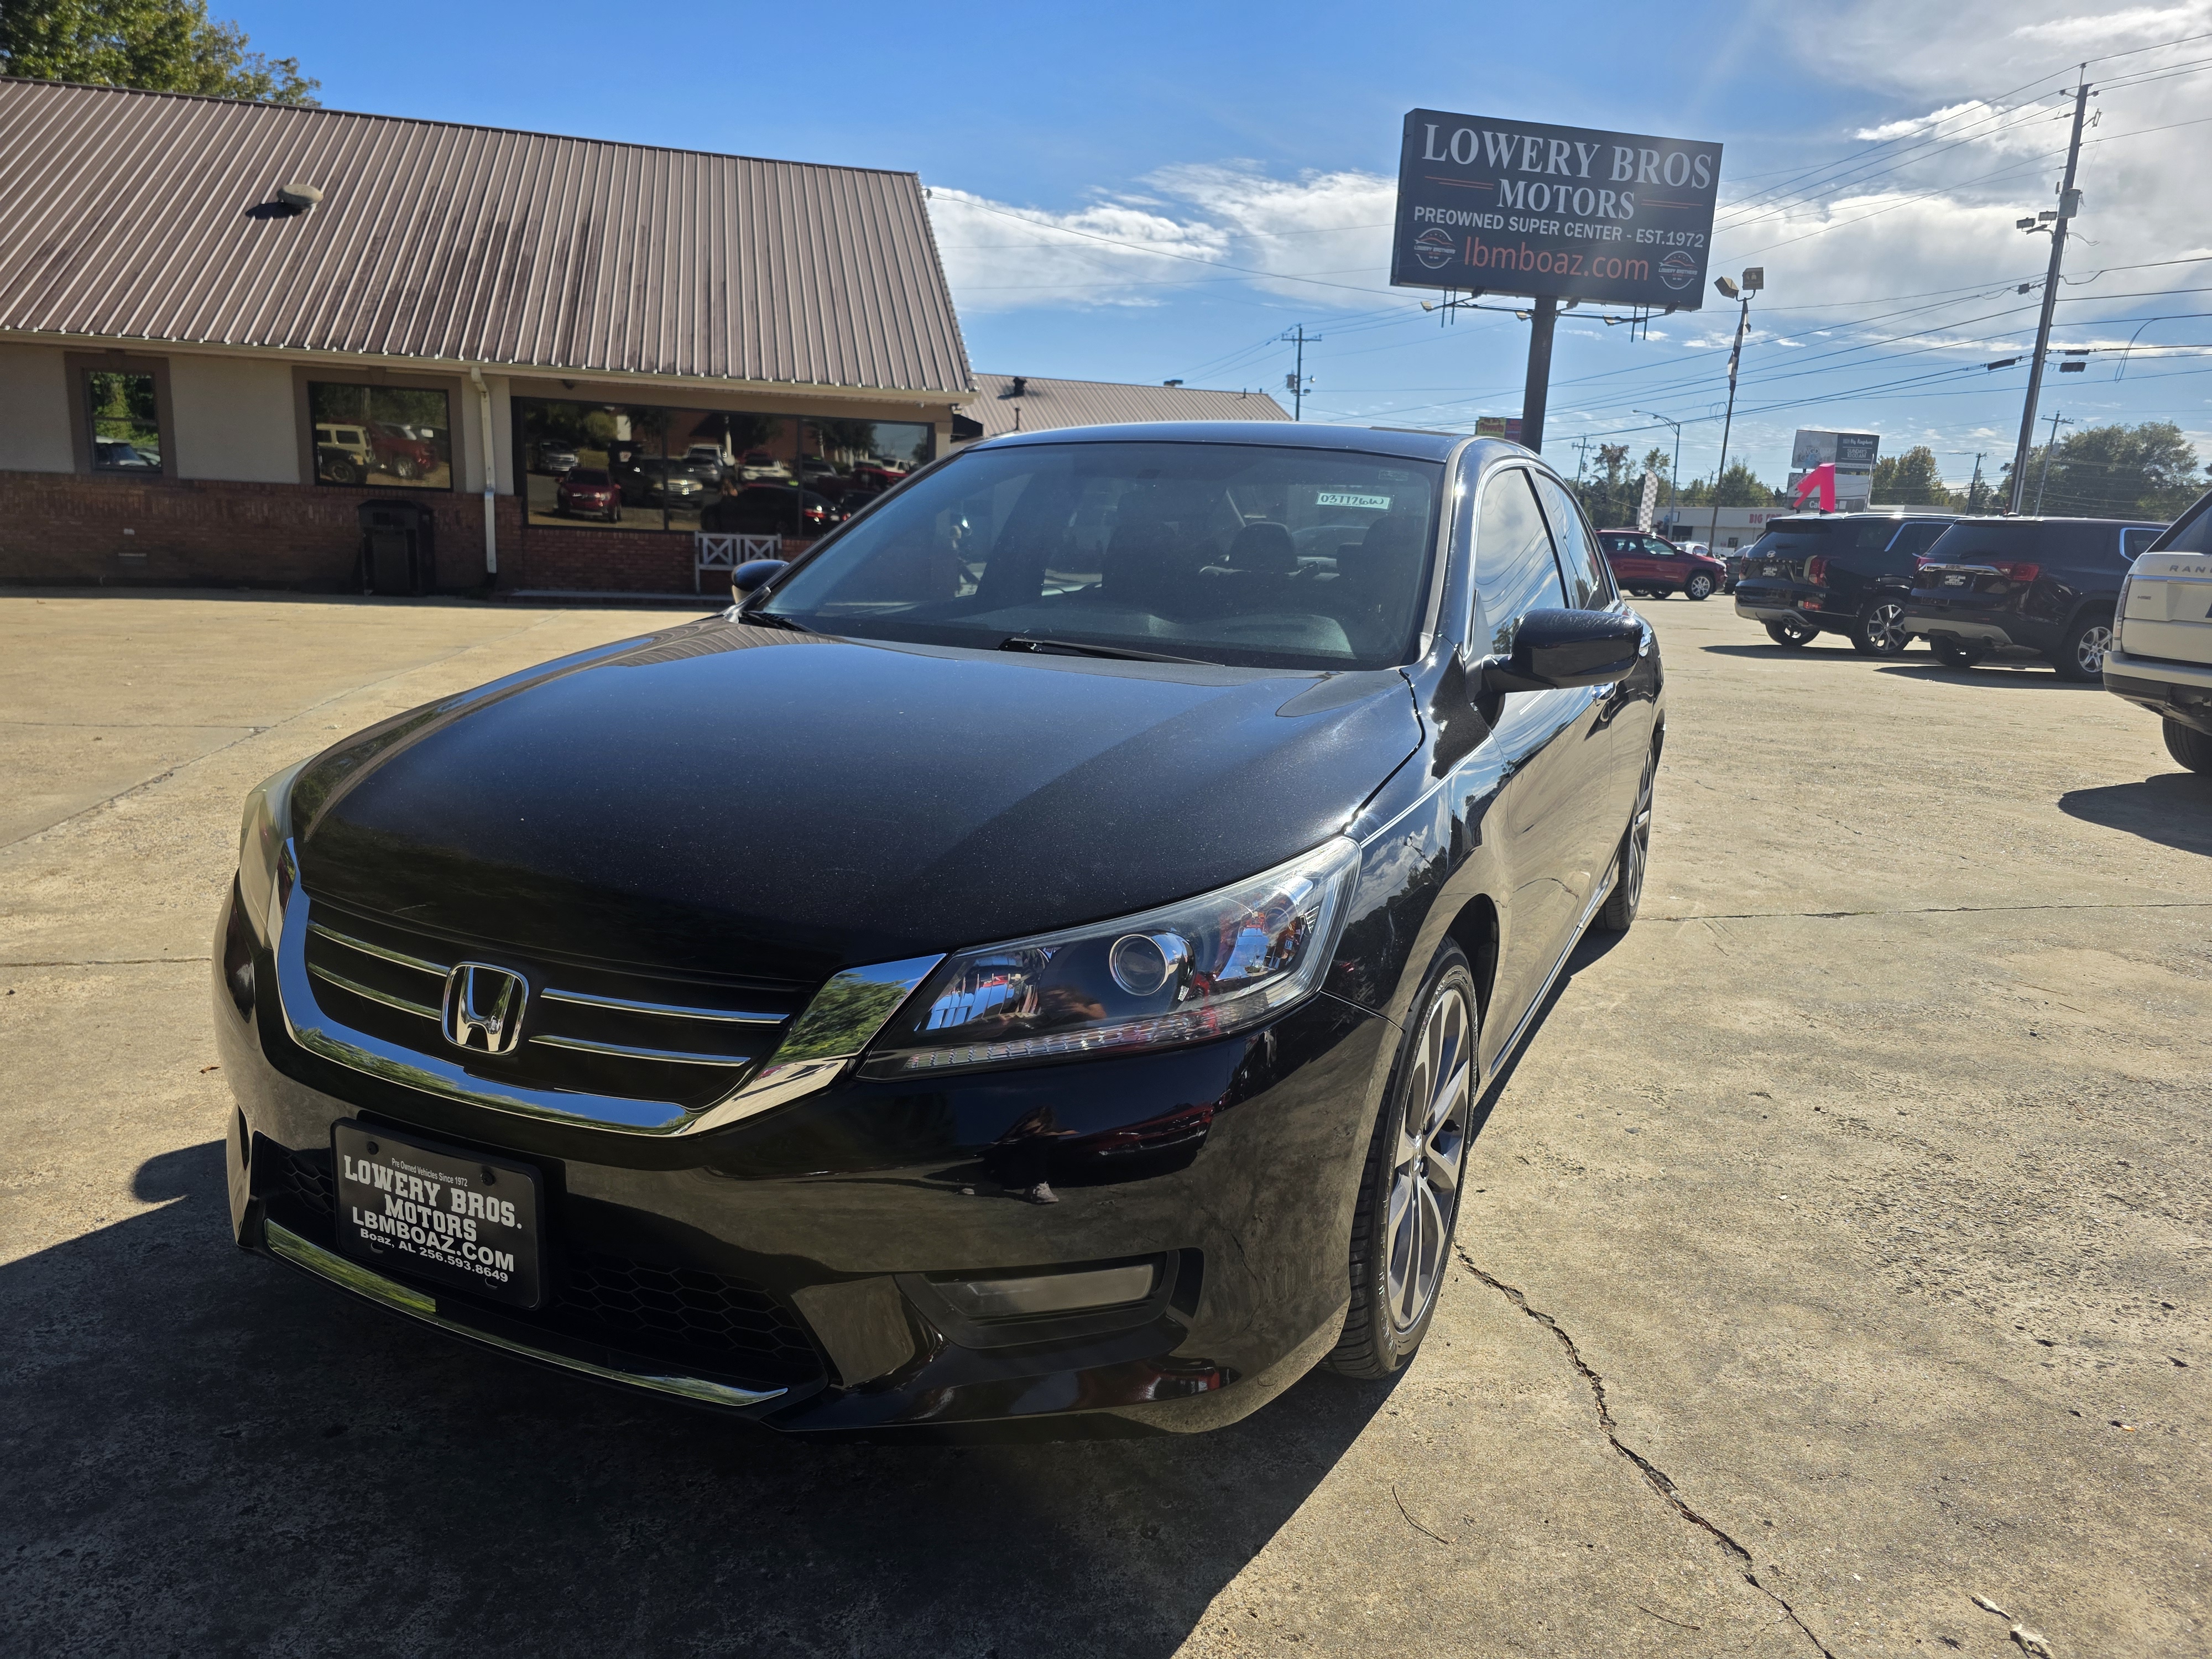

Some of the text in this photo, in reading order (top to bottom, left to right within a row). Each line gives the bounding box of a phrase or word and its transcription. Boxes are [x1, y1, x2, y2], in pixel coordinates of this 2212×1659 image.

[1422, 123, 1712, 189] LOWERY BROS
[1496, 179, 1635, 220] MOTORS
[1414, 206, 1504, 229] PREOWNED
[1508, 217, 1560, 236] SUPER
[1564, 222, 1623, 241] CENTER
[1635, 228, 1704, 248] EST.1972
[1464, 236, 1649, 281] lbmboaz.com
[1749, 514, 1763, 524] BIG
[2169, 565, 2212, 573] RAN
[344, 1155, 522, 1229] LOWERY BROS.
[392, 1157, 468, 1187] Pre Owned Vehicles Since 1972
[352, 1206, 514, 1272] LBMBOAZ.COM
[384, 1193, 477, 1242] MOTORS
[360, 1228, 508, 1282] Boaz, AL 256.593.8649
